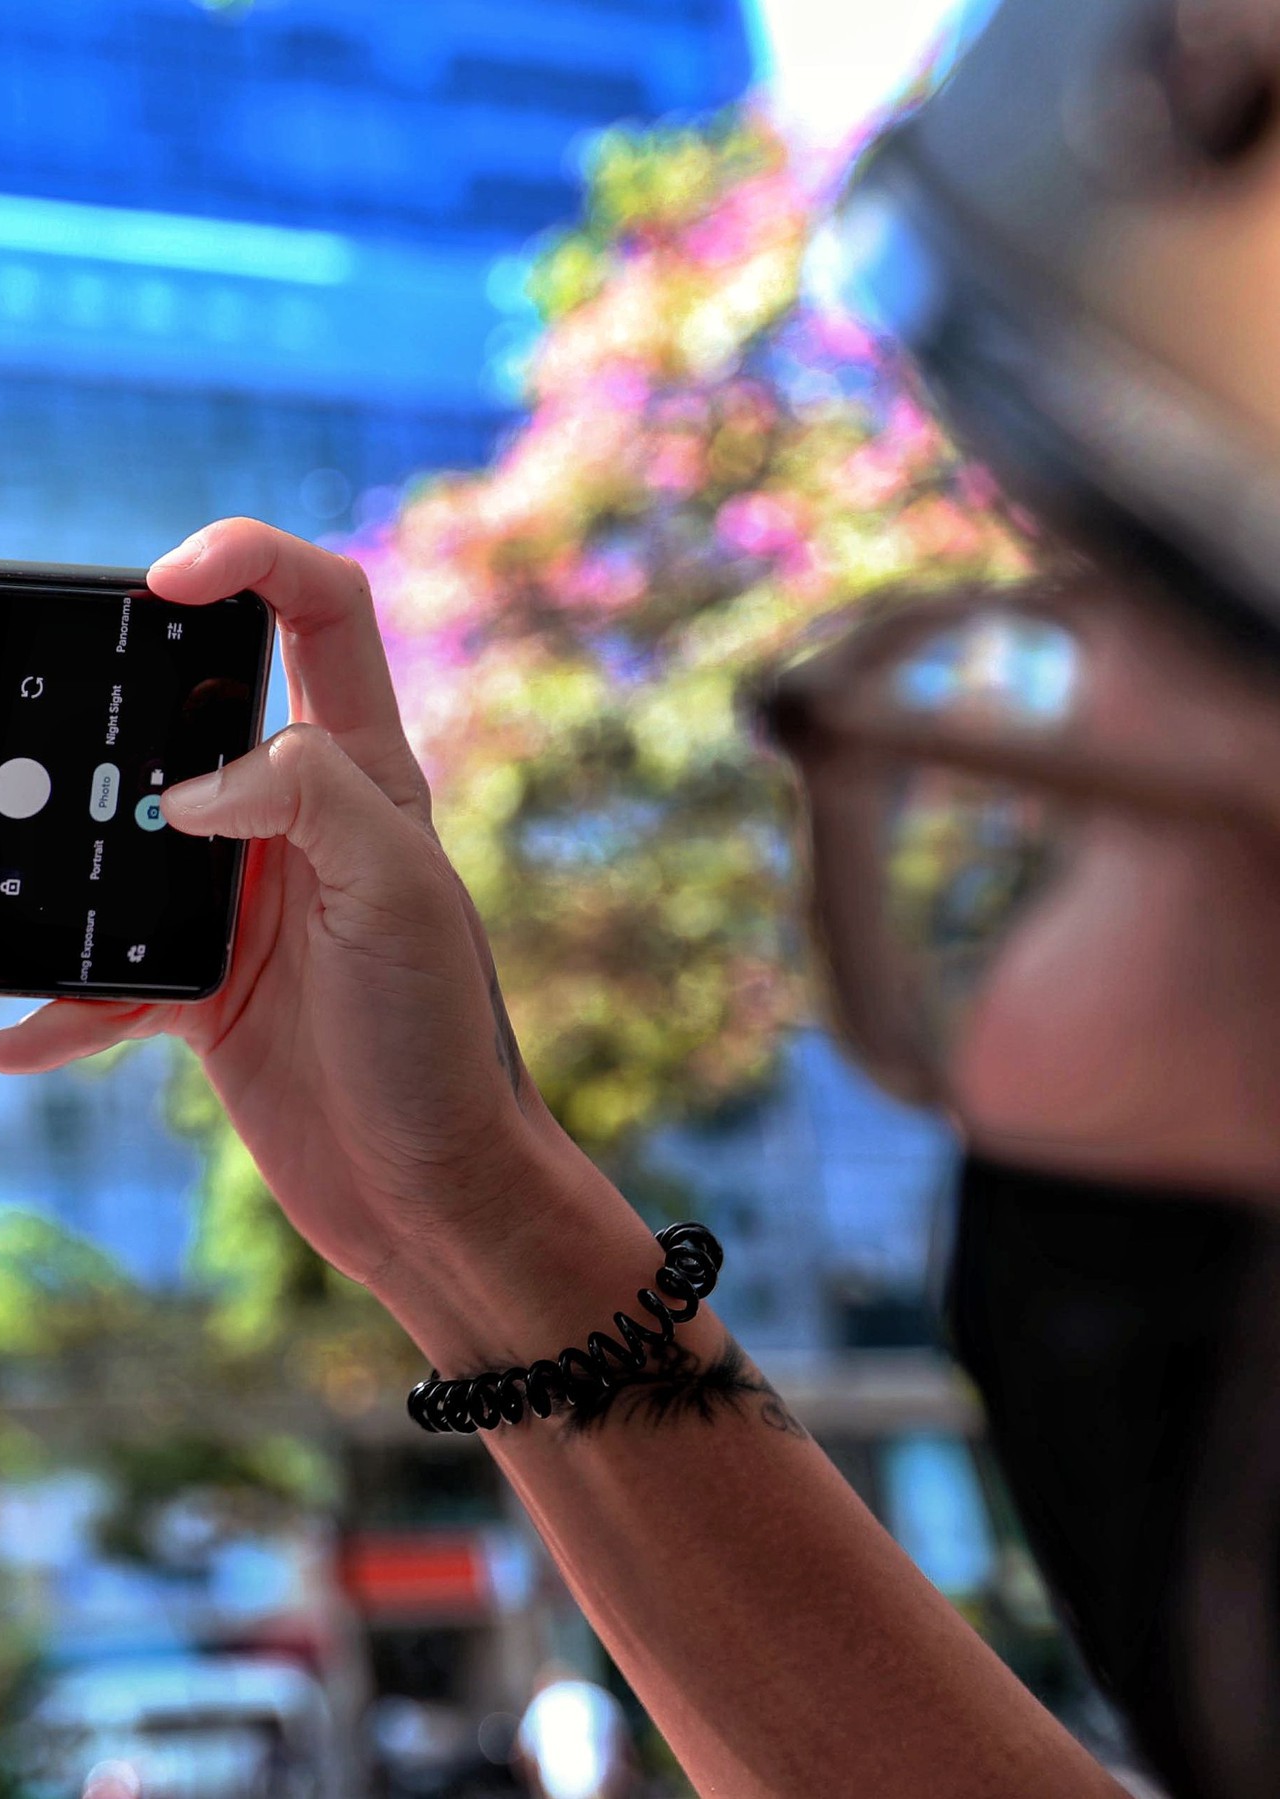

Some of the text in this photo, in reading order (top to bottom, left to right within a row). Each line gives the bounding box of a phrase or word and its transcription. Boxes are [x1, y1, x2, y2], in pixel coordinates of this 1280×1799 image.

[116, 597, 132, 653] Panorama
[105, 685, 123, 746] Night Sight
[98, 776, 111, 809] Photo
[90, 839, 104, 881] Portrait
[81, 909, 97, 959] Exposure
